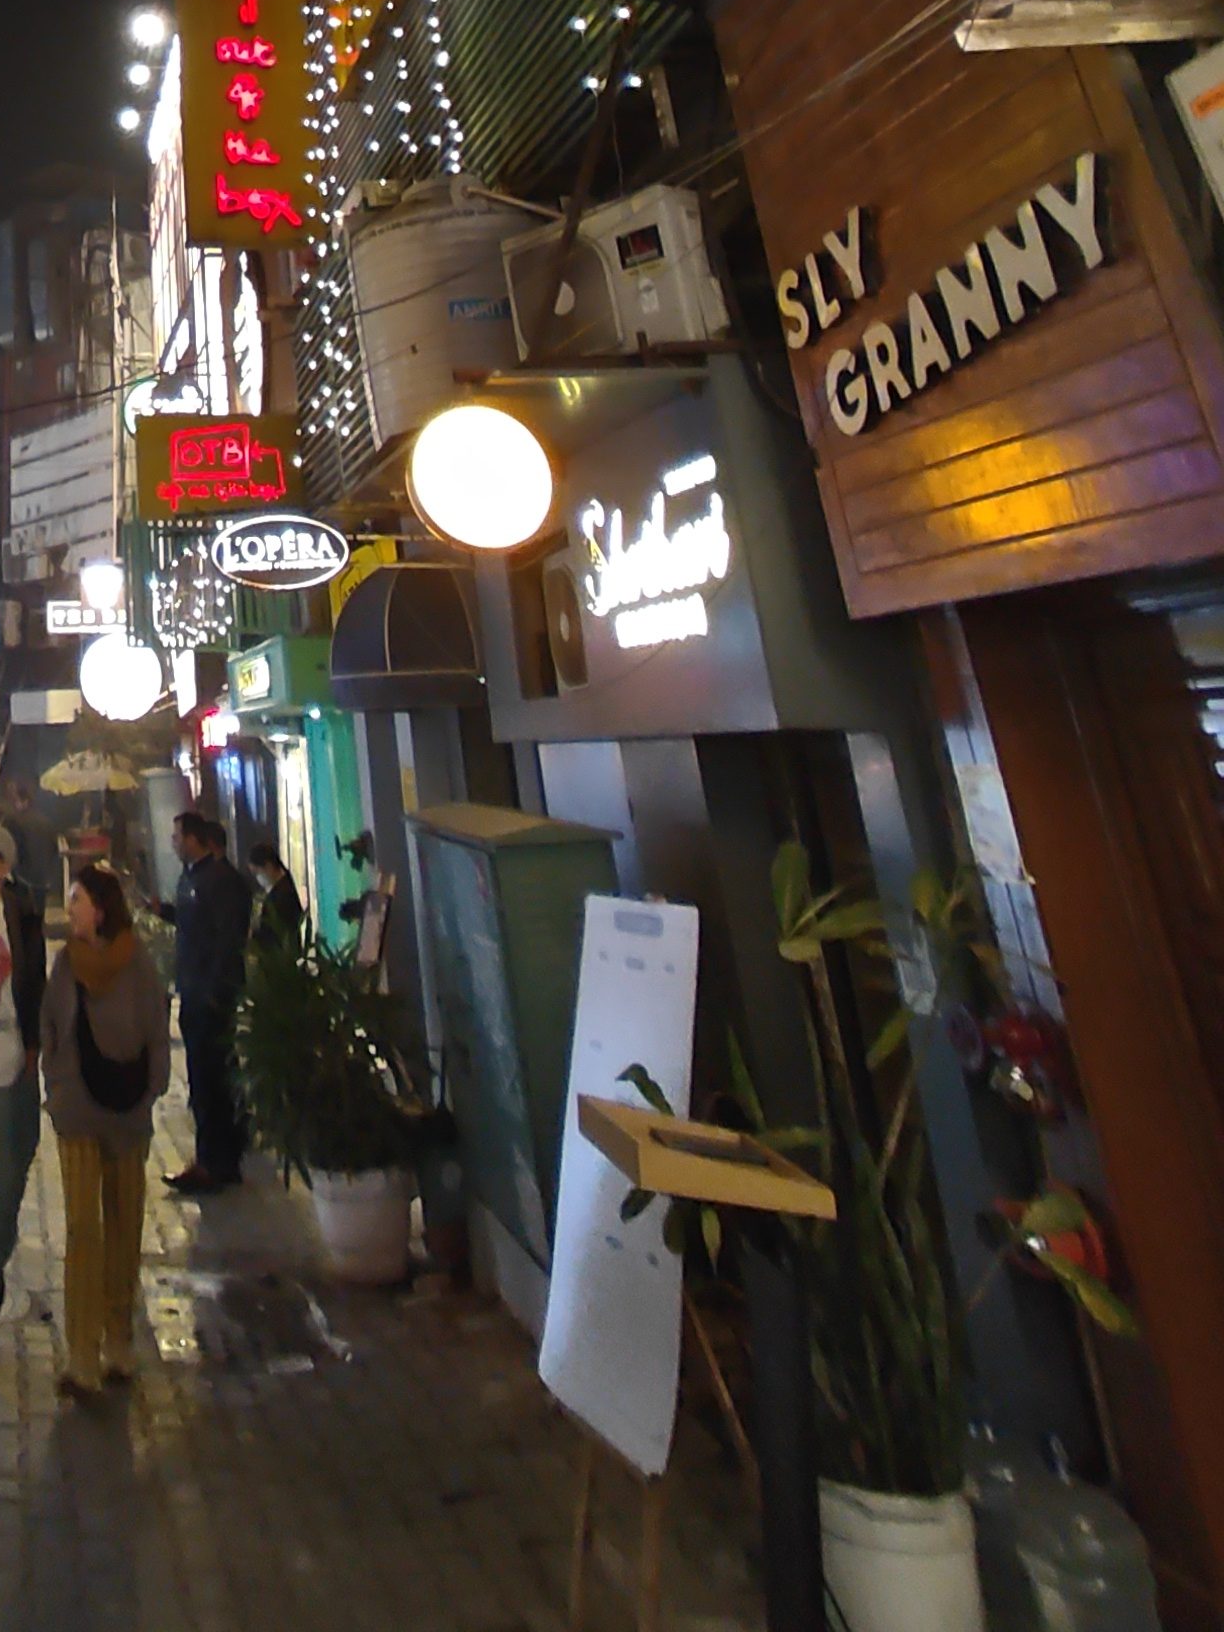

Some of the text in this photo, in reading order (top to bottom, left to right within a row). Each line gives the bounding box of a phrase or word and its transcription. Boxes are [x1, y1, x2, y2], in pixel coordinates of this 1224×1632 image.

[215, 172, 303, 234] box
[778, 205, 866, 351] SLY
[824, 151, 1106, 437] GRANNY
[180, 438, 243, 466] OTB
